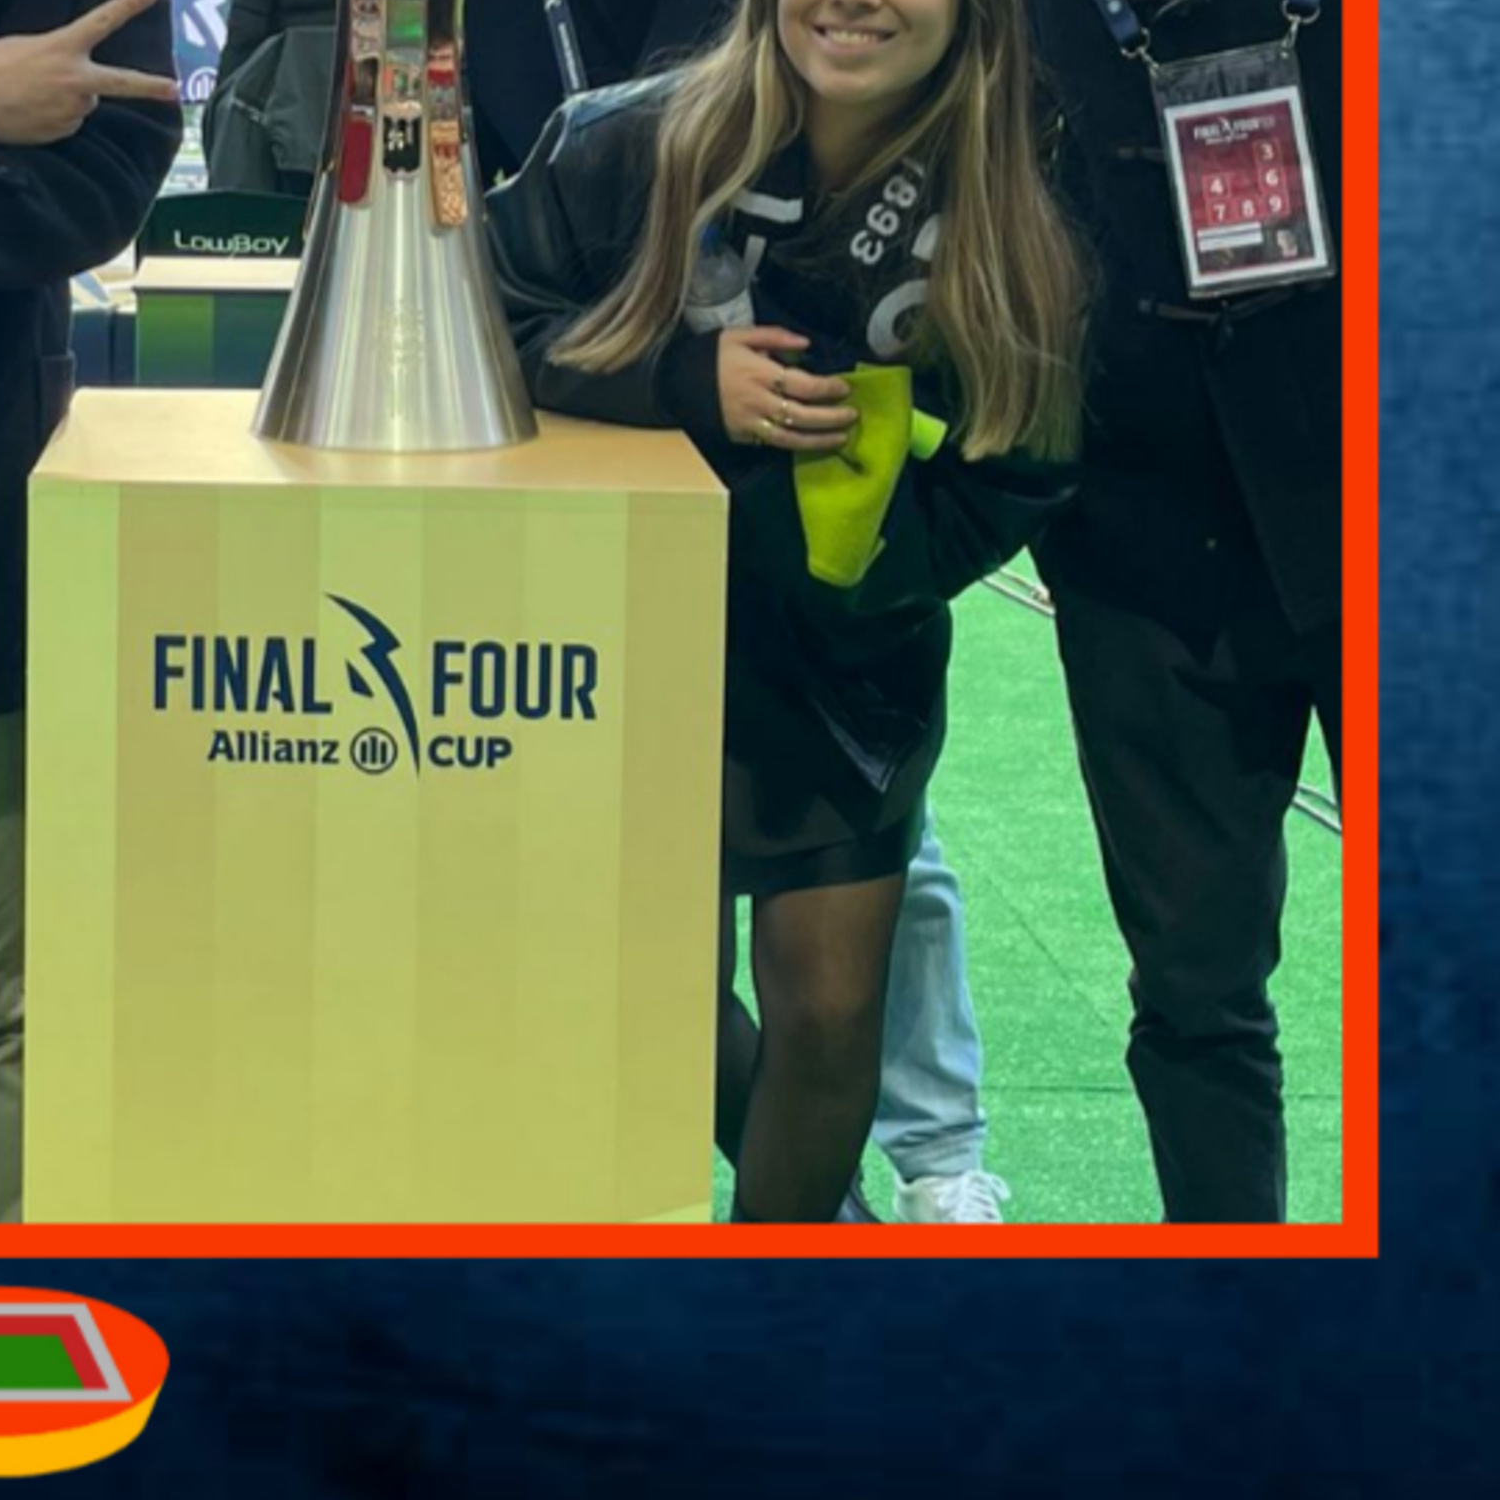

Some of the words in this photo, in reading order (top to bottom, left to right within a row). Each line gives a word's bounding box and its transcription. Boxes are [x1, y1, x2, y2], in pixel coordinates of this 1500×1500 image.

[1261, 144, 1274, 160] 3
[1211, 178, 1223, 194] 4
[1265, 170, 1279, 186] 6
[1214, 205, 1226, 221] 7
[1242, 200, 1254, 217] 8
[1269, 196, 1282, 212] 9
[173, 229, 290, 255] LowBoy
[153, 634, 333, 715] FINAL
[432, 641, 598, 720] FOUR
[207, 730, 340, 766] Allianz
[428, 735, 513, 769] CUP
